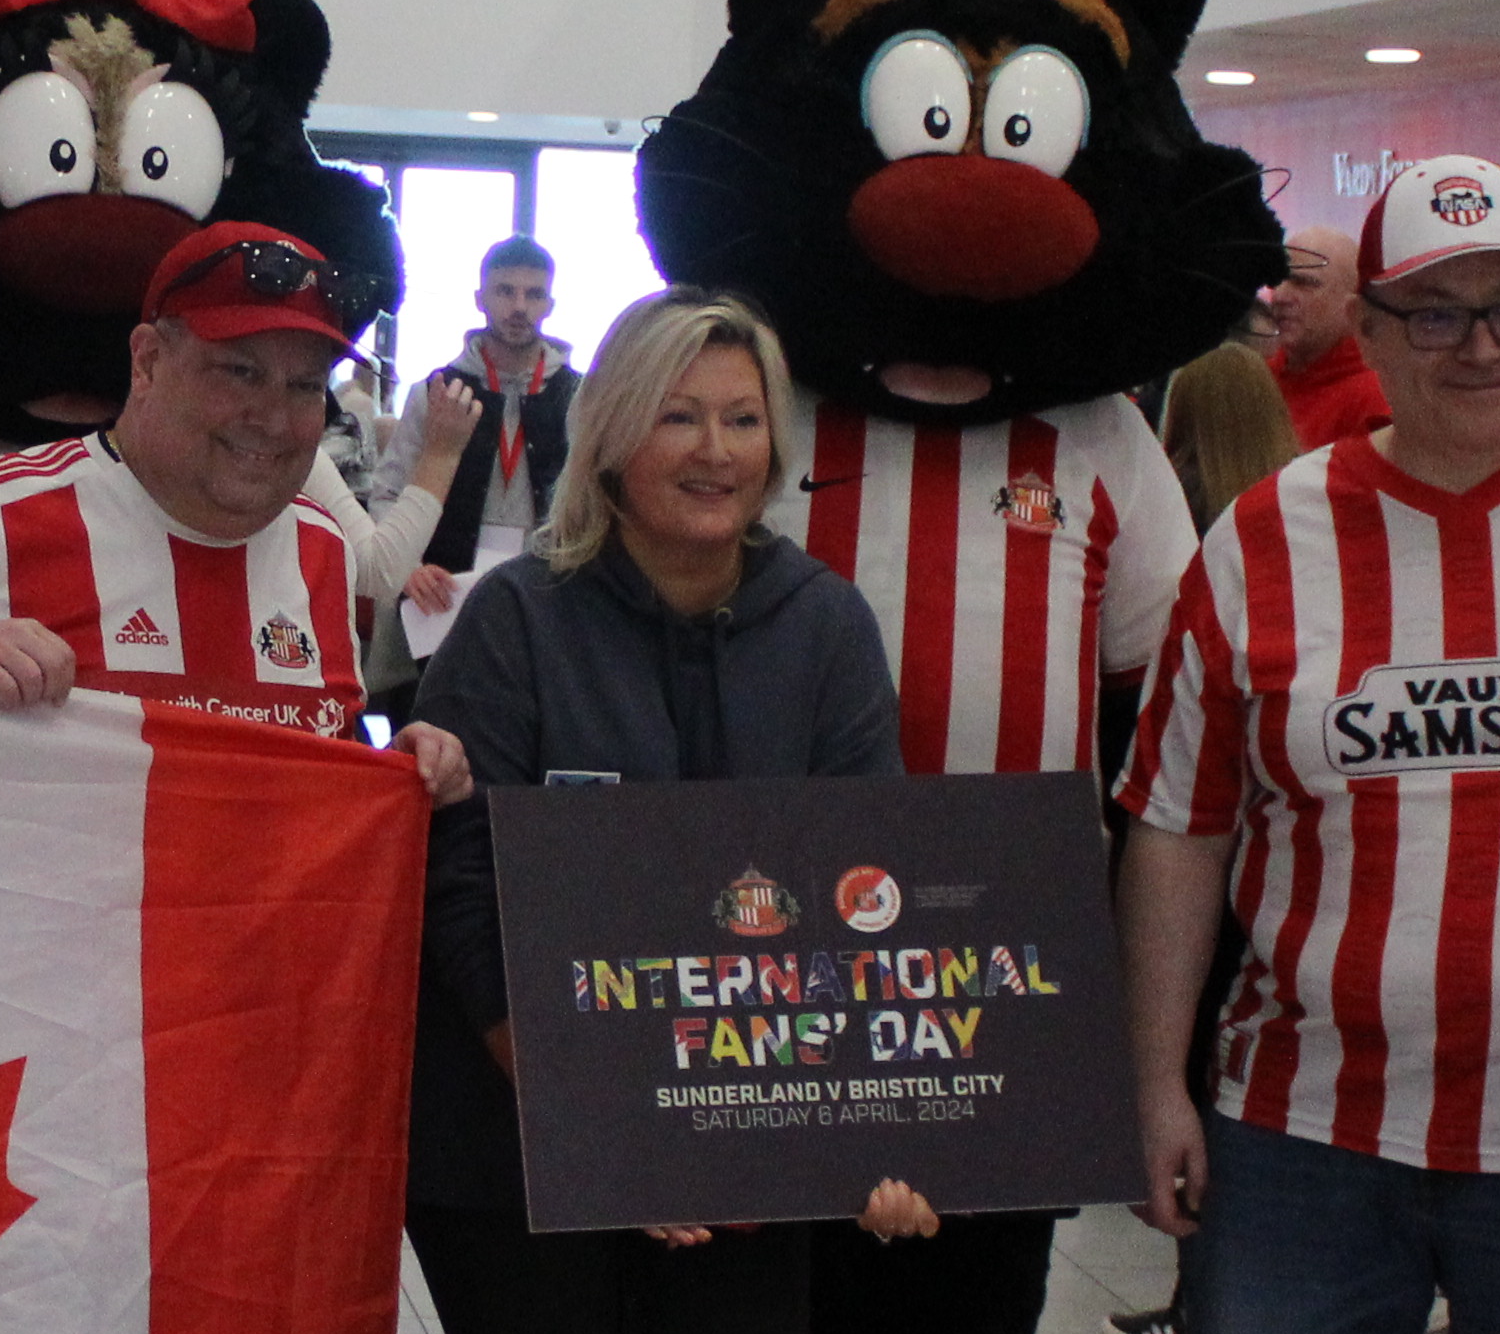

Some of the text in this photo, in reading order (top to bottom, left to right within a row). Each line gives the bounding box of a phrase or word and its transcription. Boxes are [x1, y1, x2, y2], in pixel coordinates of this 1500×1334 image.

[115, 631, 169, 647] adidas
[206, 698, 271, 723] Cancer
[274, 704, 302, 726] UK
[573, 945, 1061, 1012] INTERNATIONAL
[869, 1006, 982, 1062] DAY
[657, 1074, 1006, 1108] SUNDERLAND V BRISTOL CITY
[692, 1107, 811, 1132] SATURDAY
[818, 1105, 833, 1127] 6
[917, 1100, 977, 1122] 2024
